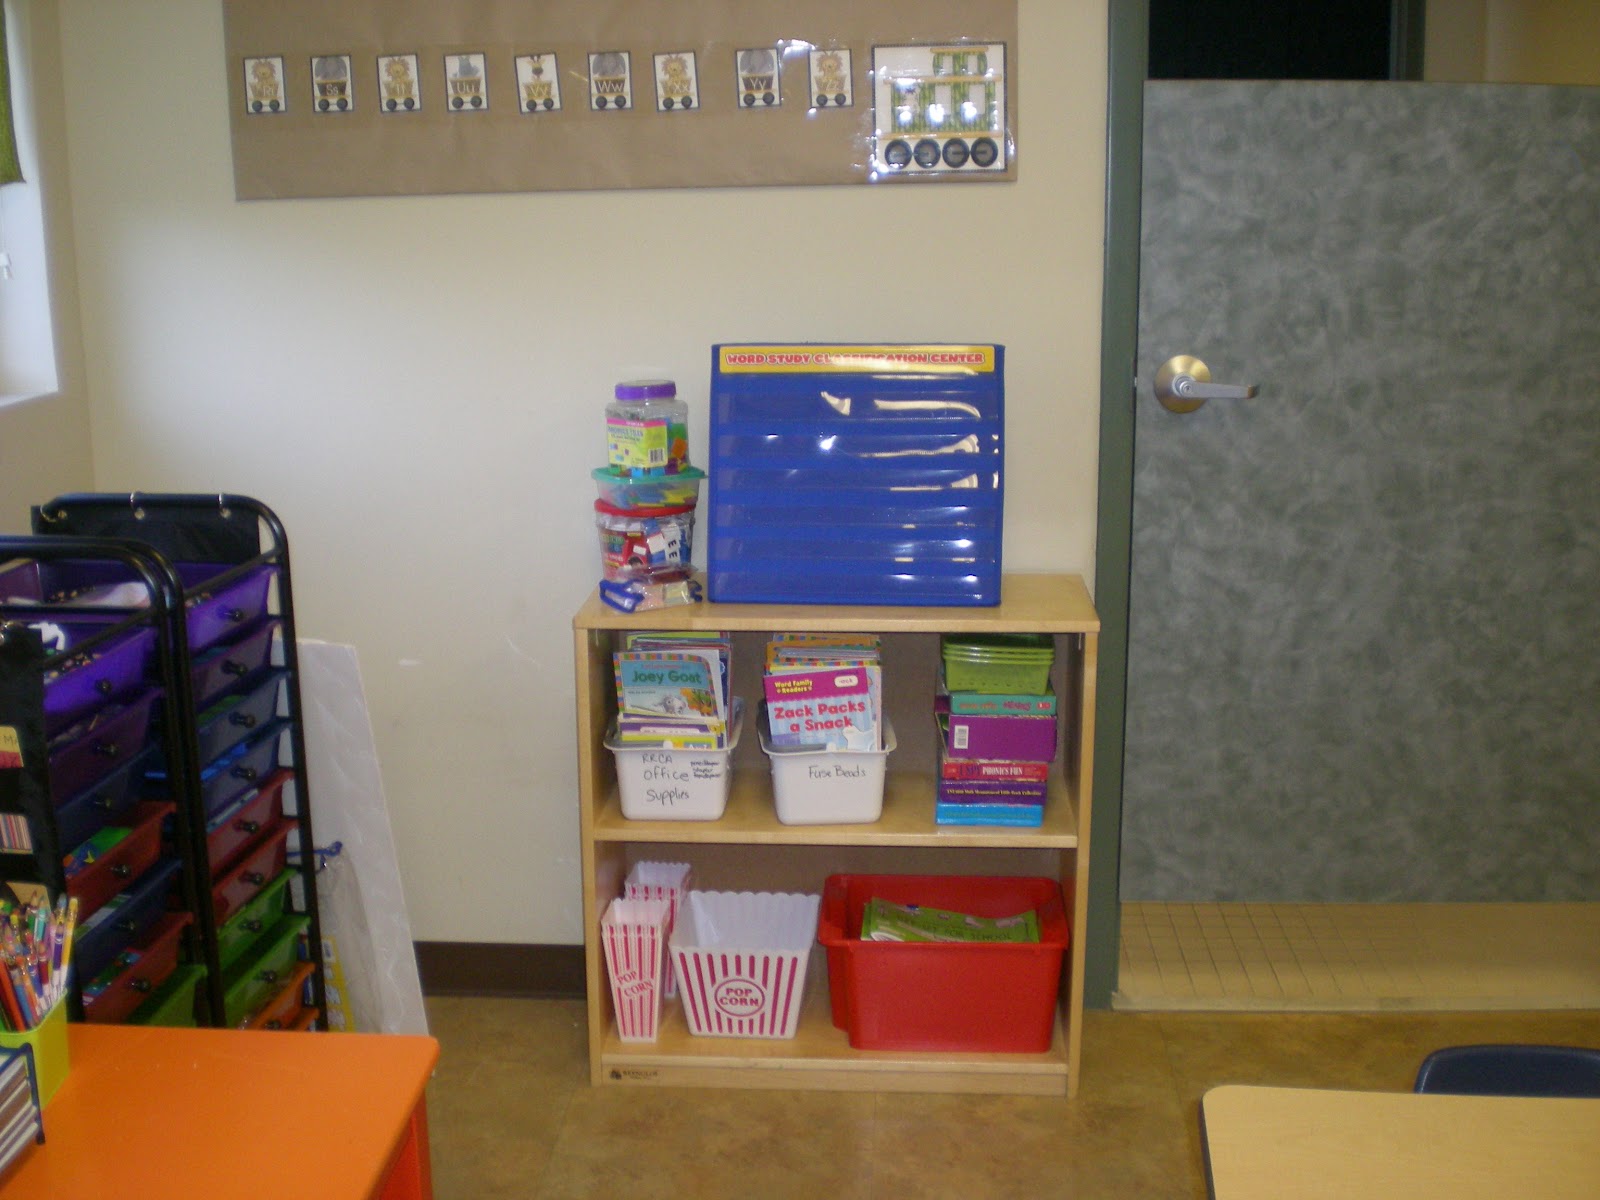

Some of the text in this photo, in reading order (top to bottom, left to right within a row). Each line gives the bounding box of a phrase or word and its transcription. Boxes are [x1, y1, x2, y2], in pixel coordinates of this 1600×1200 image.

[326, 84, 339, 95] Ss
[456, 81, 475, 94] Uu
[598, 81, 624, 93] Ww
[749, 78, 767, 91] Yy
[726, 354, 765, 365] WORD
[767, 353, 812, 365] STUDY
[930, 353, 985, 364] CENTER
[632, 670, 702, 684] Joey Goat
[793, 679, 813, 687] Family
[774, 701, 866, 719] Zack Packs
[790, 716, 853, 732] a Snack
[642, 753, 672, 763] RRCA
[809, 764, 866, 778] Fuse Beads
[982, 766, 1009, 775] PHONICS
[617, 971, 637, 985] POP
[624, 980, 654, 997] CORN
[725, 988, 752, 997] POP
[719, 996, 759, 1006] CORN
